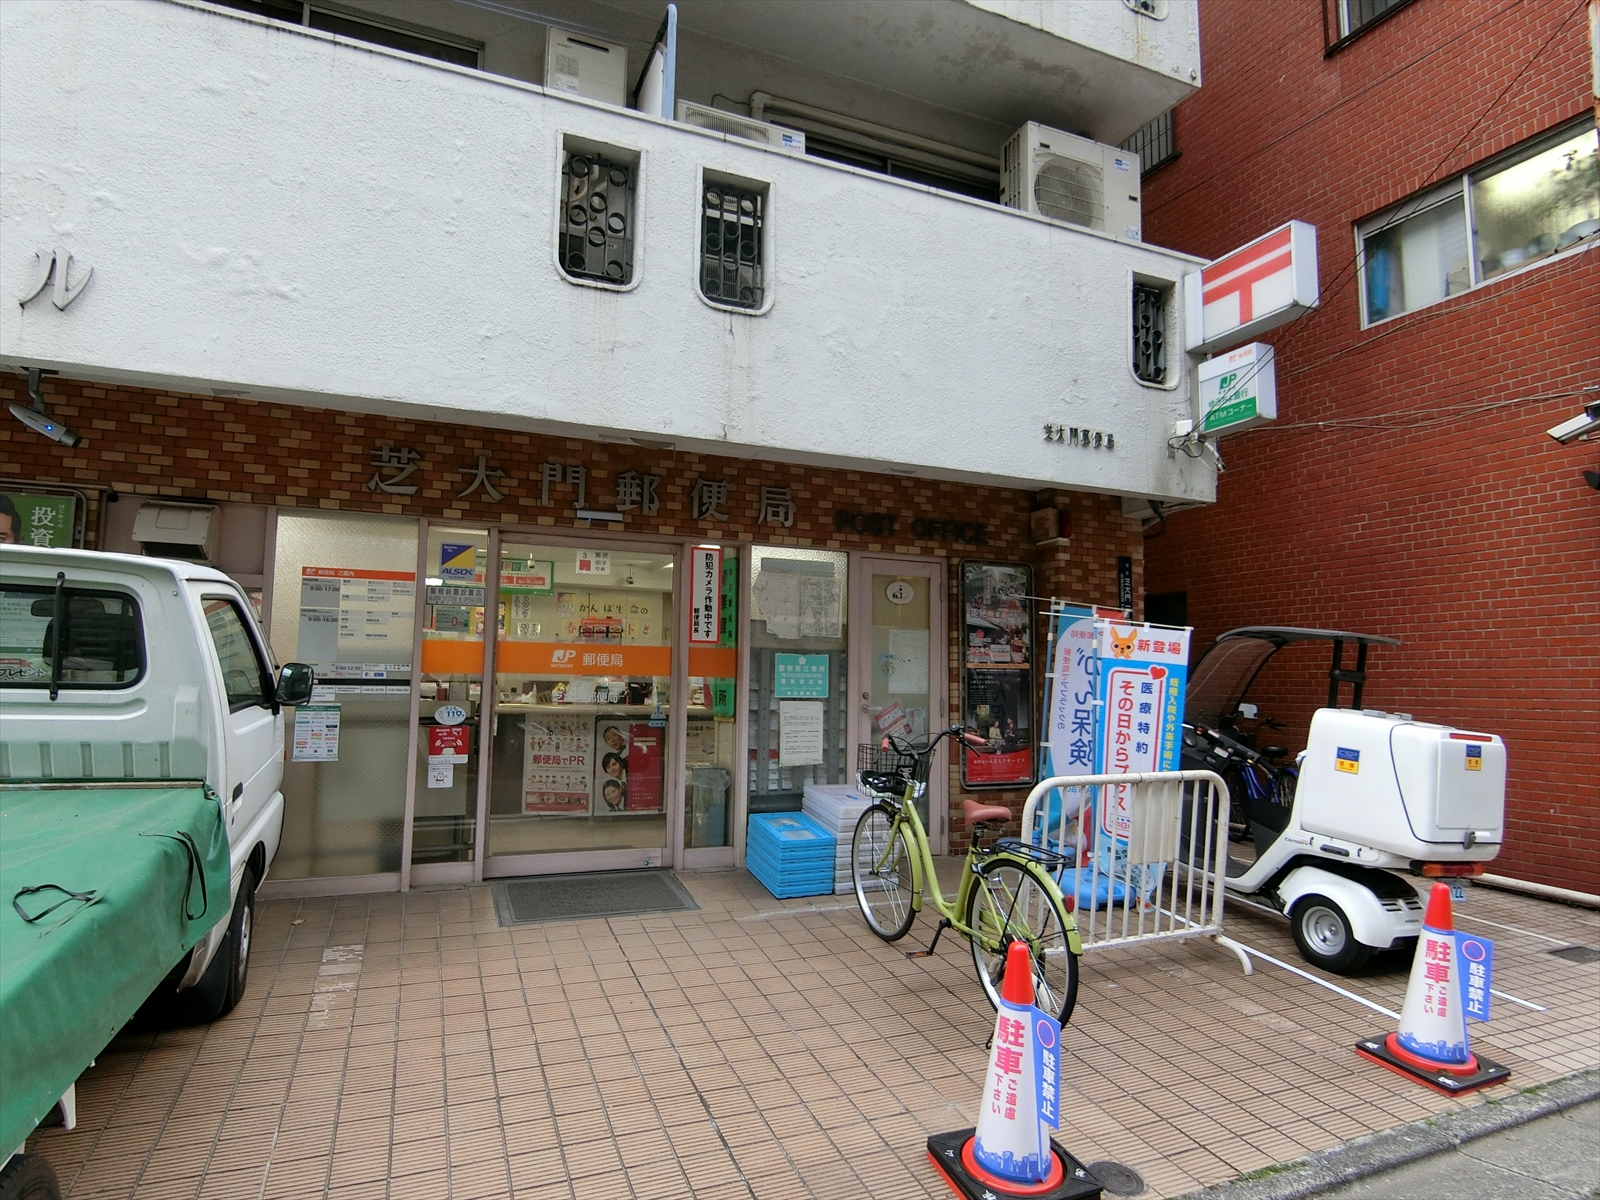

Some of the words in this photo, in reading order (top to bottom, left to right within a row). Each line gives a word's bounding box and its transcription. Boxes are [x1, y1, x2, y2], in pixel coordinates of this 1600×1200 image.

[1219, 372, 1238, 391] JP
[1209, 404, 1253, 422] ATMコーナー
[366, 445, 798, 528] 芝大門郵便局
[31, 507, 56, 548] 投資
[835, 509, 898, 537] POST
[910, 517, 989, 546] OFFICE
[441, 568, 473, 576] ALSOK
[579, 603, 649, 615] かんぽ生命の
[704, 552, 714, 639] 防犯カメラ作動中です
[551, 649, 577, 663] JP
[582, 652, 624, 667] 郵便局
[1137, 638, 1182, 655] 新登場
[1135, 682, 1154, 755] 医療特約
[1163, 677, 1179, 772] 短期入院や外来手術に
[532, 754, 586, 766] 郵便局でPR
[1424, 938, 1451, 984] 駐車
[1423, 982, 1435, 1014] 下さい
[1437, 985, 1447, 1018] ご遠慮
[1466, 961, 1486, 1015] 駐車禁止
[994, 1015, 1026, 1075] 駐車
[992, 1072, 1004, 1115] 下さい
[1004, 1078, 1018, 1121] ご遠慮
[1040, 1048, 1056, 1120] 駐車禁止
